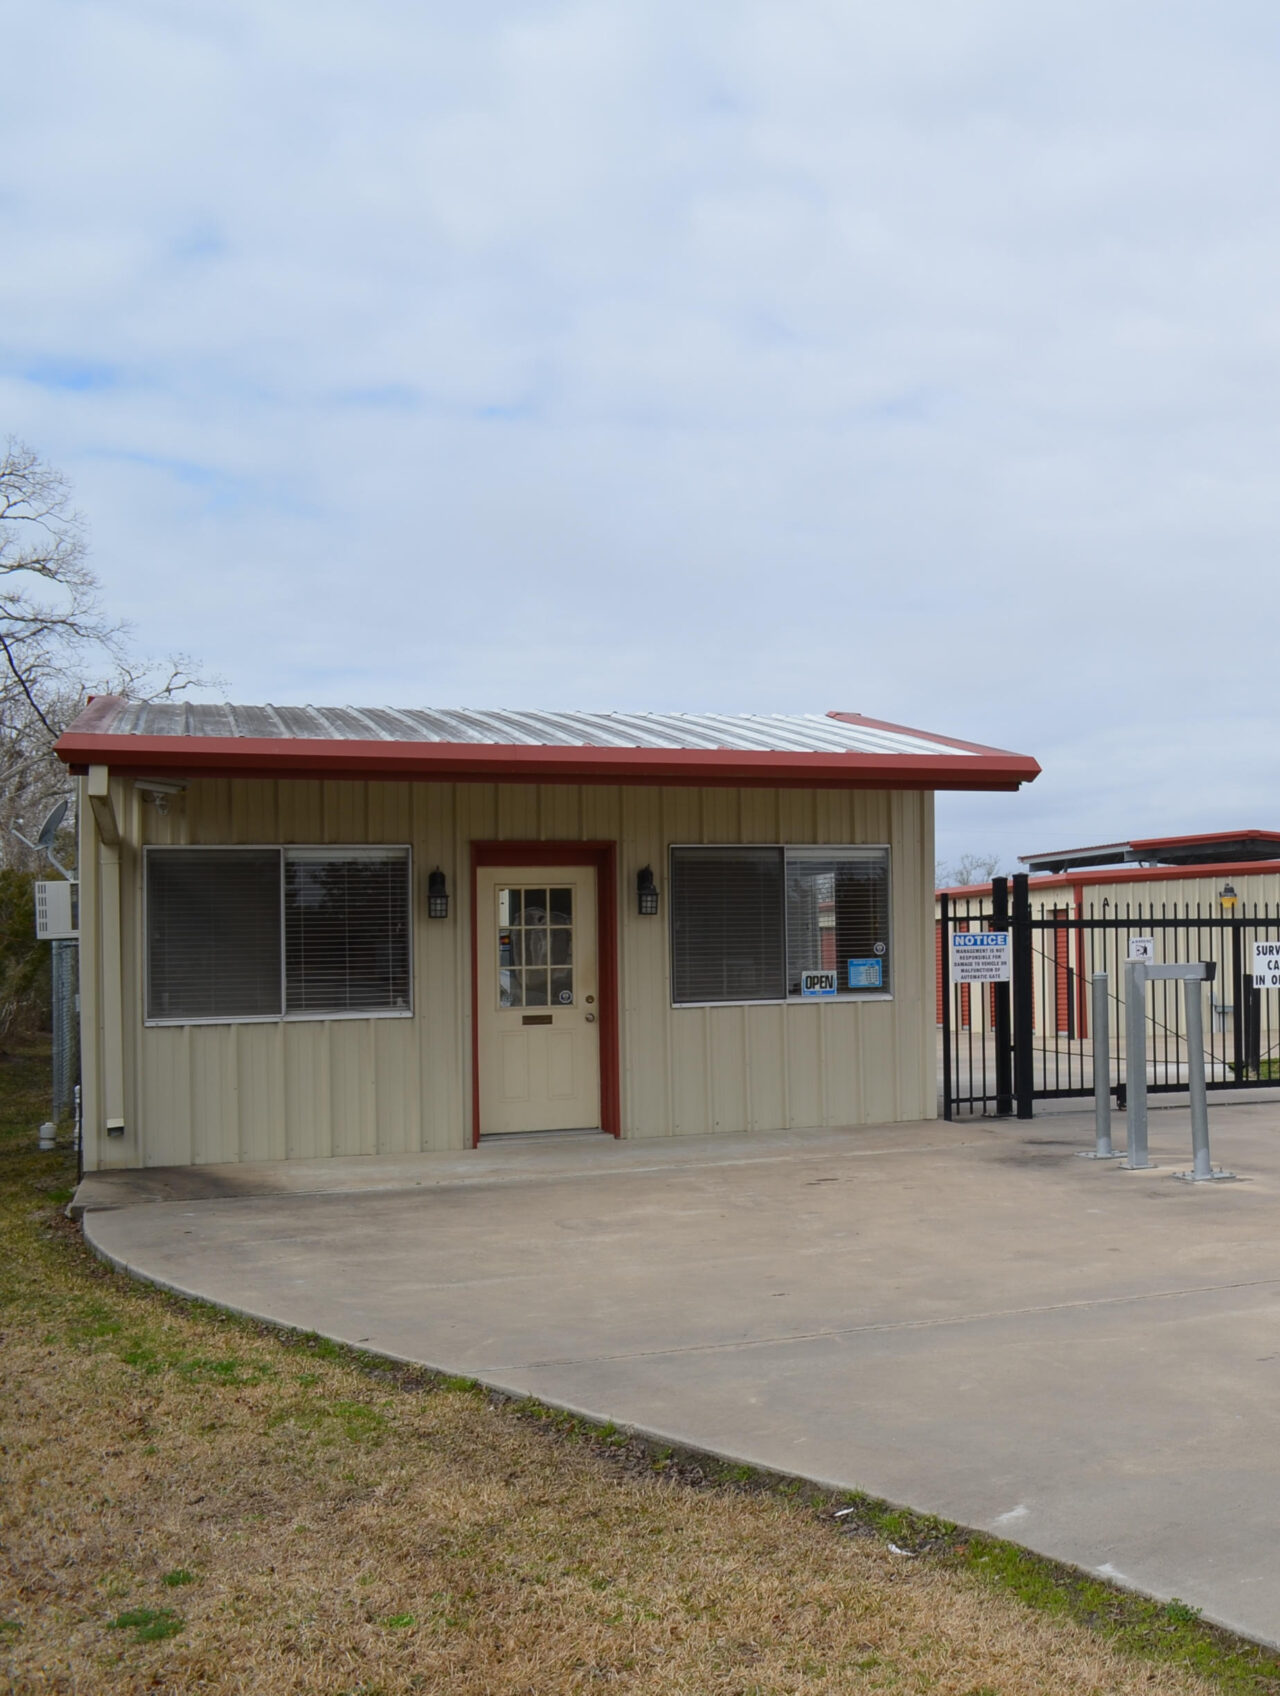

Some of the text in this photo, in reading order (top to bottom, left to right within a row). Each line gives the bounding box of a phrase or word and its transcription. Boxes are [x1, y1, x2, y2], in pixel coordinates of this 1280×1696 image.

[1103, 897, 1109, 907] A
[955, 935, 1005, 946] NOTICE
[805, 975, 833, 990] OPEN
[1255, 975, 1266, 985] IN
